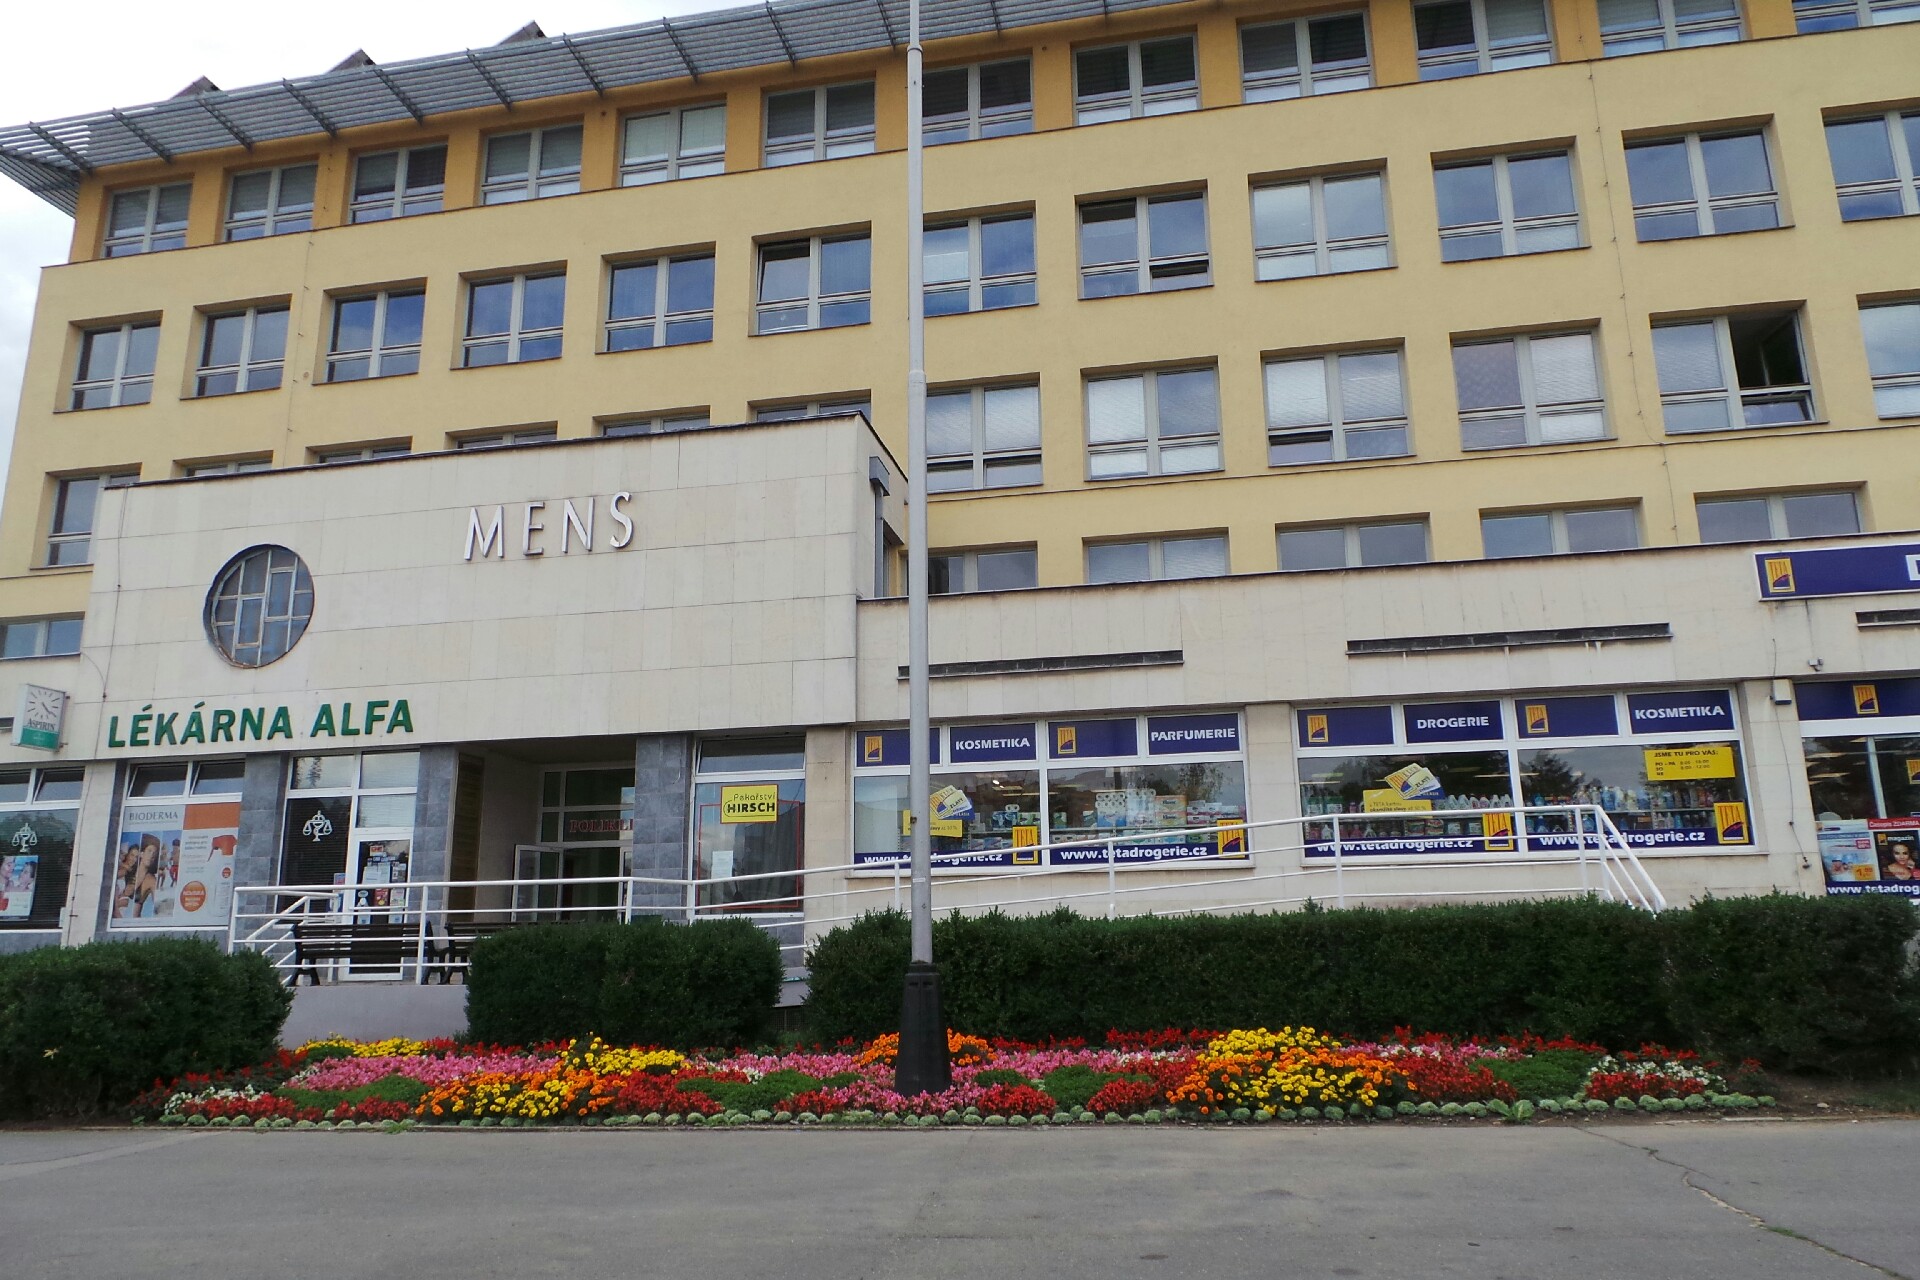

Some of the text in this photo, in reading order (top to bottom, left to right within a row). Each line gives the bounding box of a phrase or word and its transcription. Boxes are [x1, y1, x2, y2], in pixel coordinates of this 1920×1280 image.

[464, 491, 634, 561] MENS
[1635, 705, 1725, 720] KOSMETIKA
[27, 718, 56, 731] ASPIRIN
[108, 700, 413, 748] LÉKÁRNA ALFA
[1417, 716, 1489, 729] DROGERIE
[1151, 728, 1236, 741] PARFUMERIE
[955, 738, 1030, 751] KOSMETIKA
[733, 791, 776, 802] Pekařství
[727, 802, 775, 813] HIRSCH
[129, 811, 178, 821] BIODERMA
